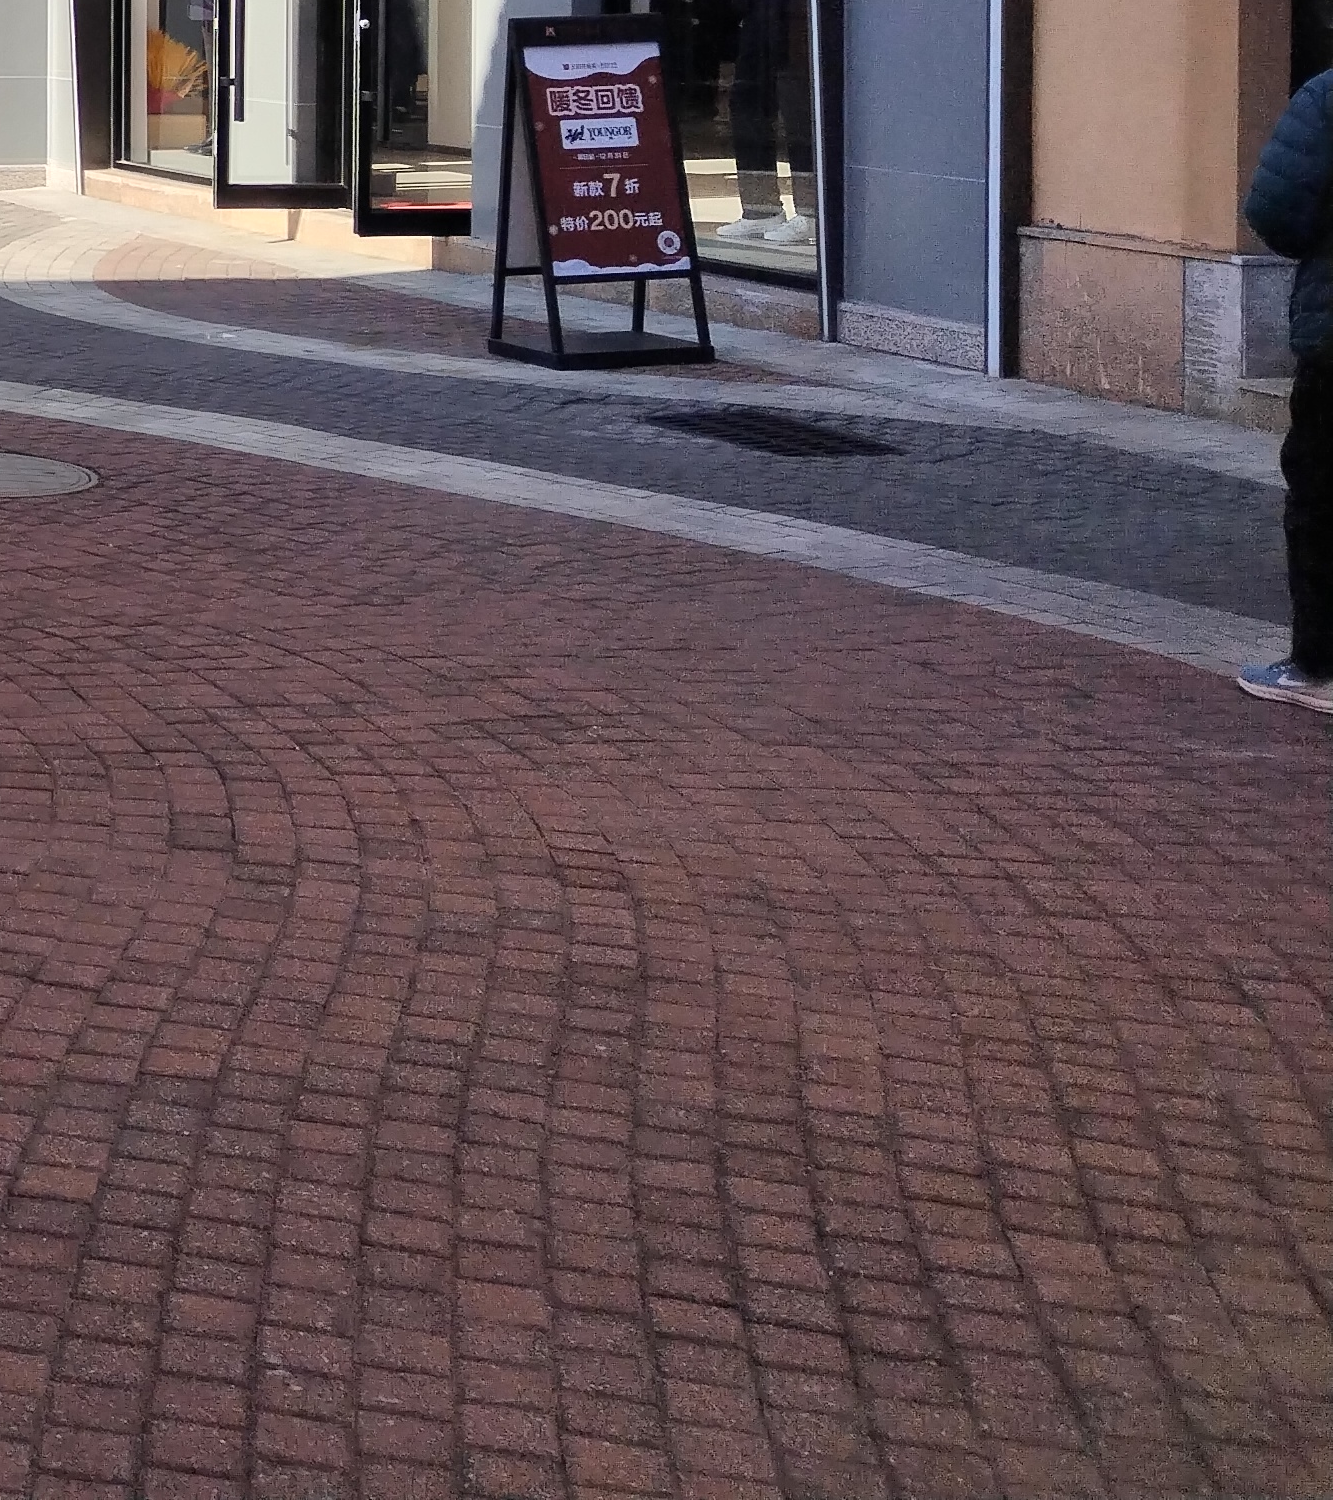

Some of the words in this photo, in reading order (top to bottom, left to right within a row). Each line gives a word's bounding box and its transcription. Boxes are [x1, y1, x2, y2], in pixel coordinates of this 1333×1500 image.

[548, 85, 643, 115] 暖冬回馈
[586, 125, 632, 138] YOUNGOR
[560, 209, 663, 232] 特价200元起
